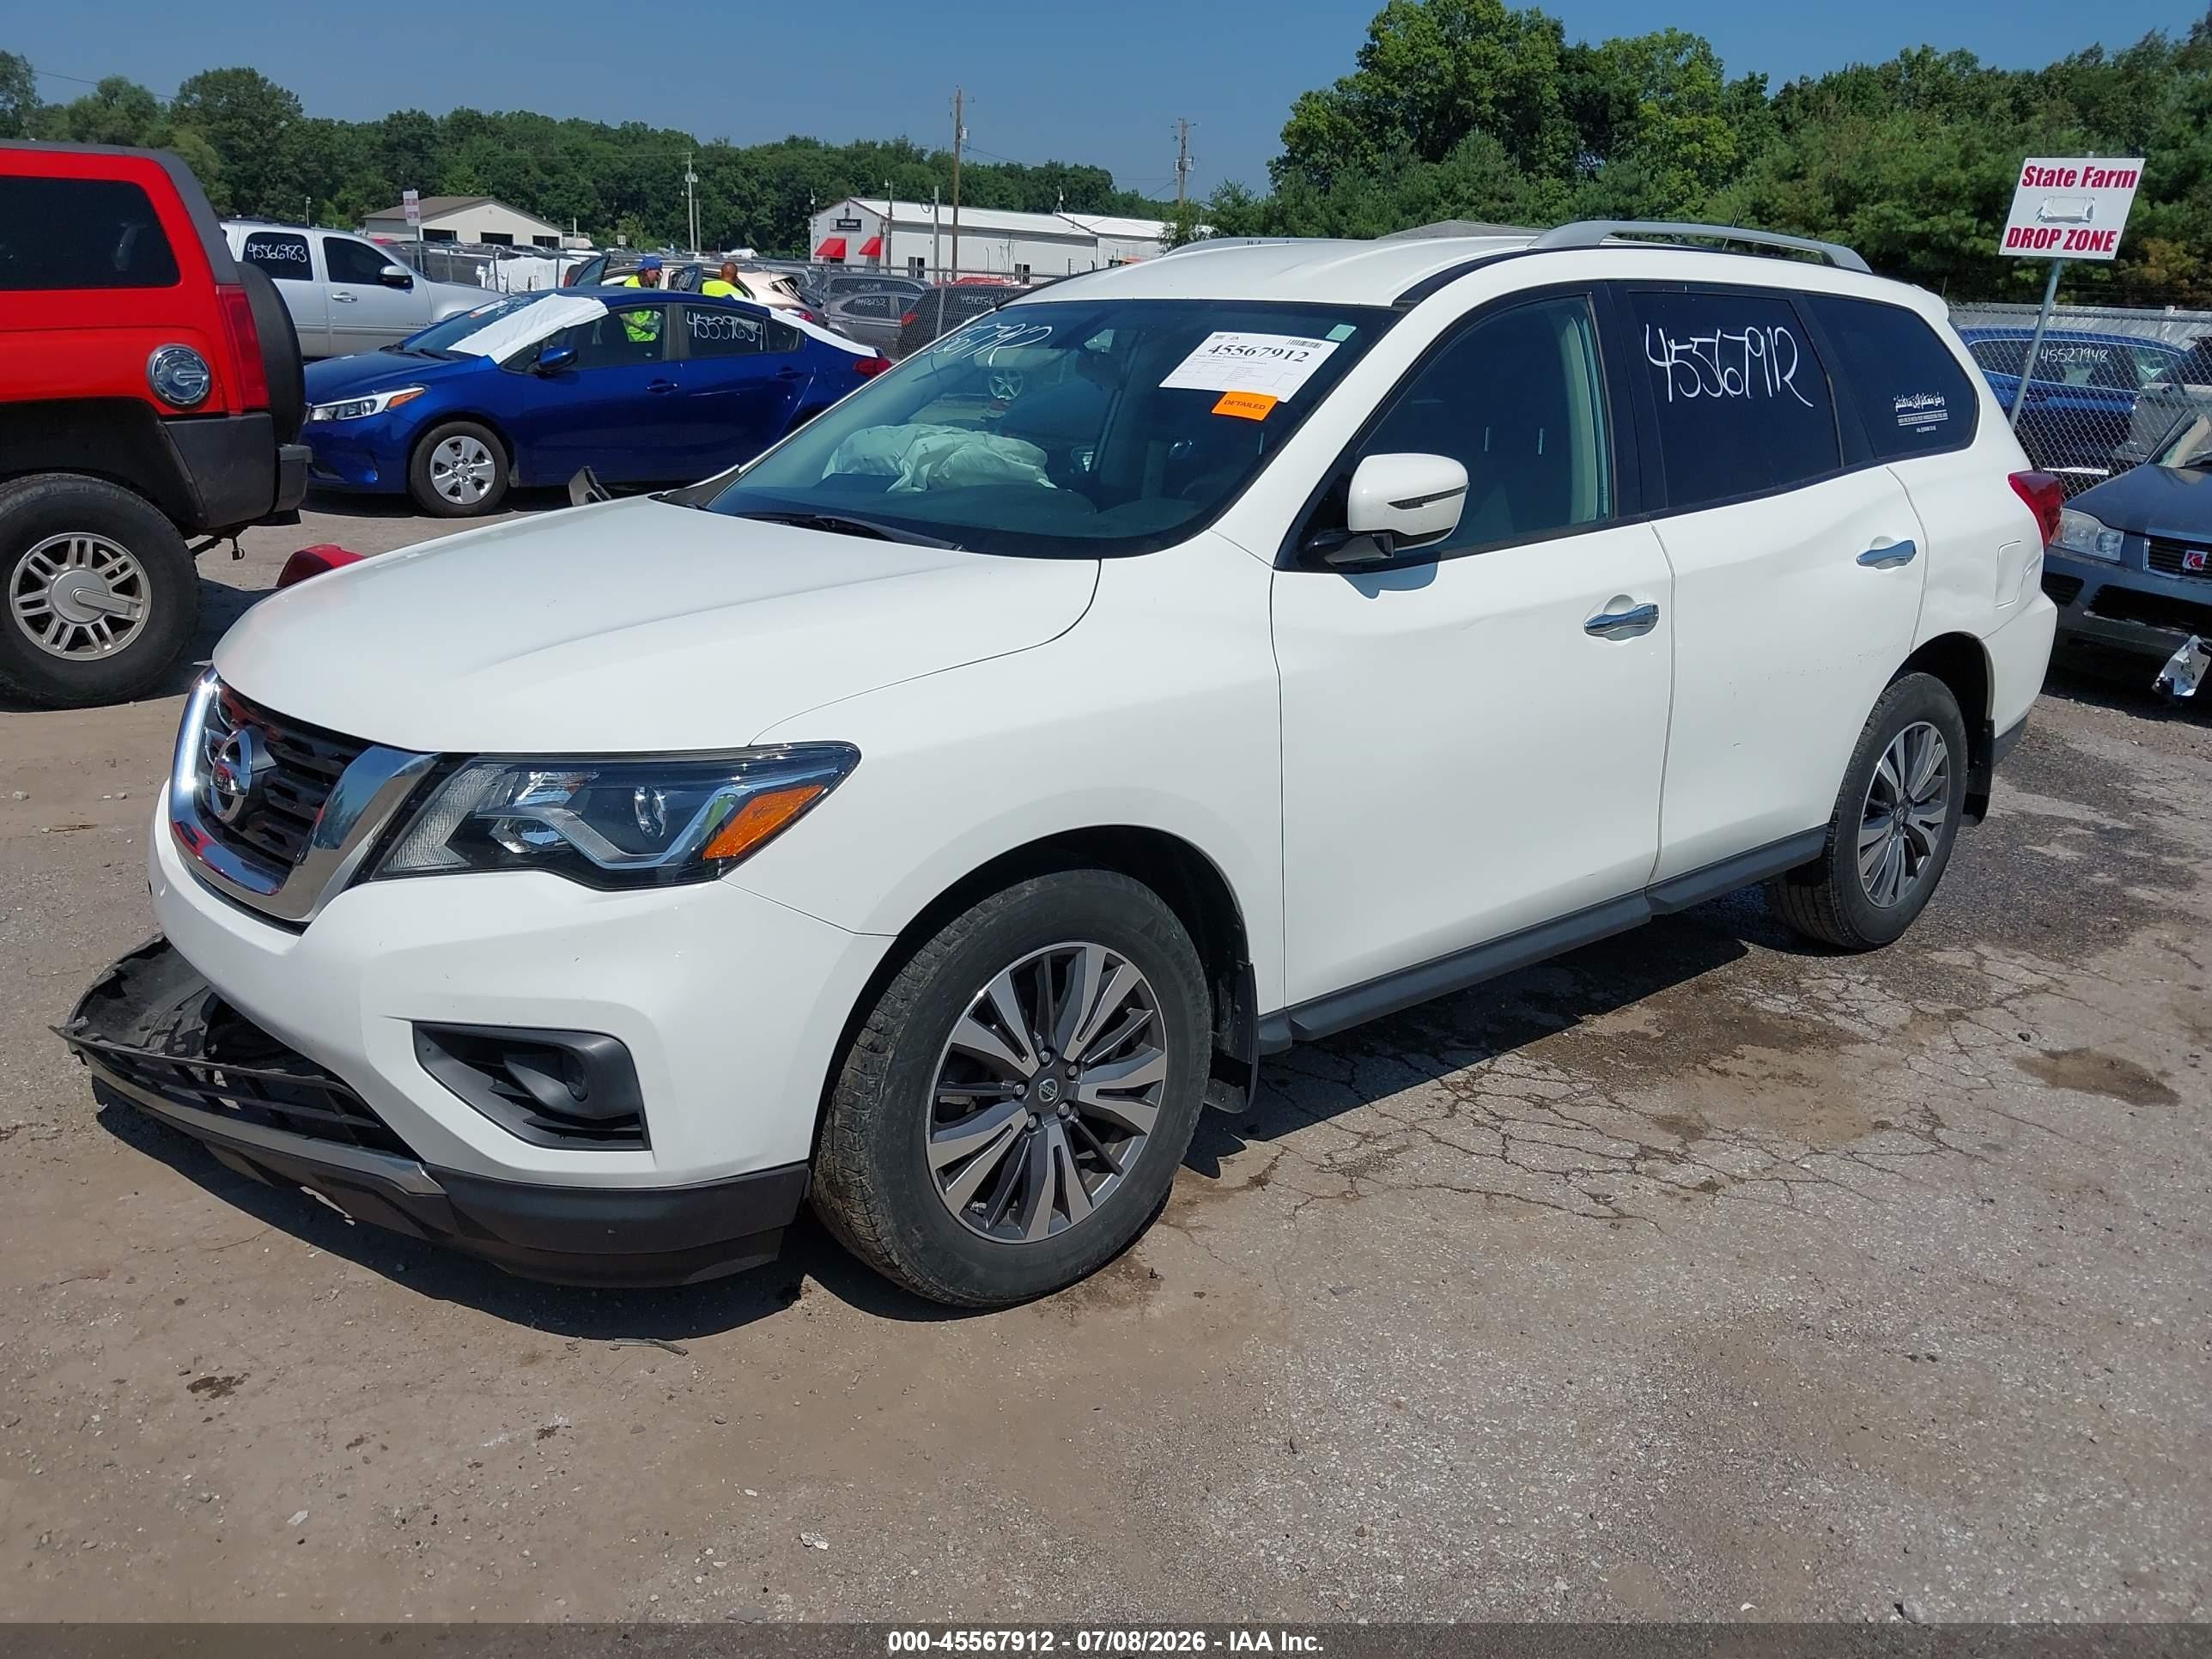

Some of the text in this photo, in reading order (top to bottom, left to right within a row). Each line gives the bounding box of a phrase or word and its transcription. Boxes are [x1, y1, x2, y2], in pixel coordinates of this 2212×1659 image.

[2021, 165, 2137, 189] State Farm
[2005, 227, 2118, 252] DROP ZONE
[247, 242, 307, 263] 45566983
[1207, 343, 1310, 362] 45567912
[2040, 347, 2109, 364] 45527948
[1224, 399, 1266, 410] DETAILED
